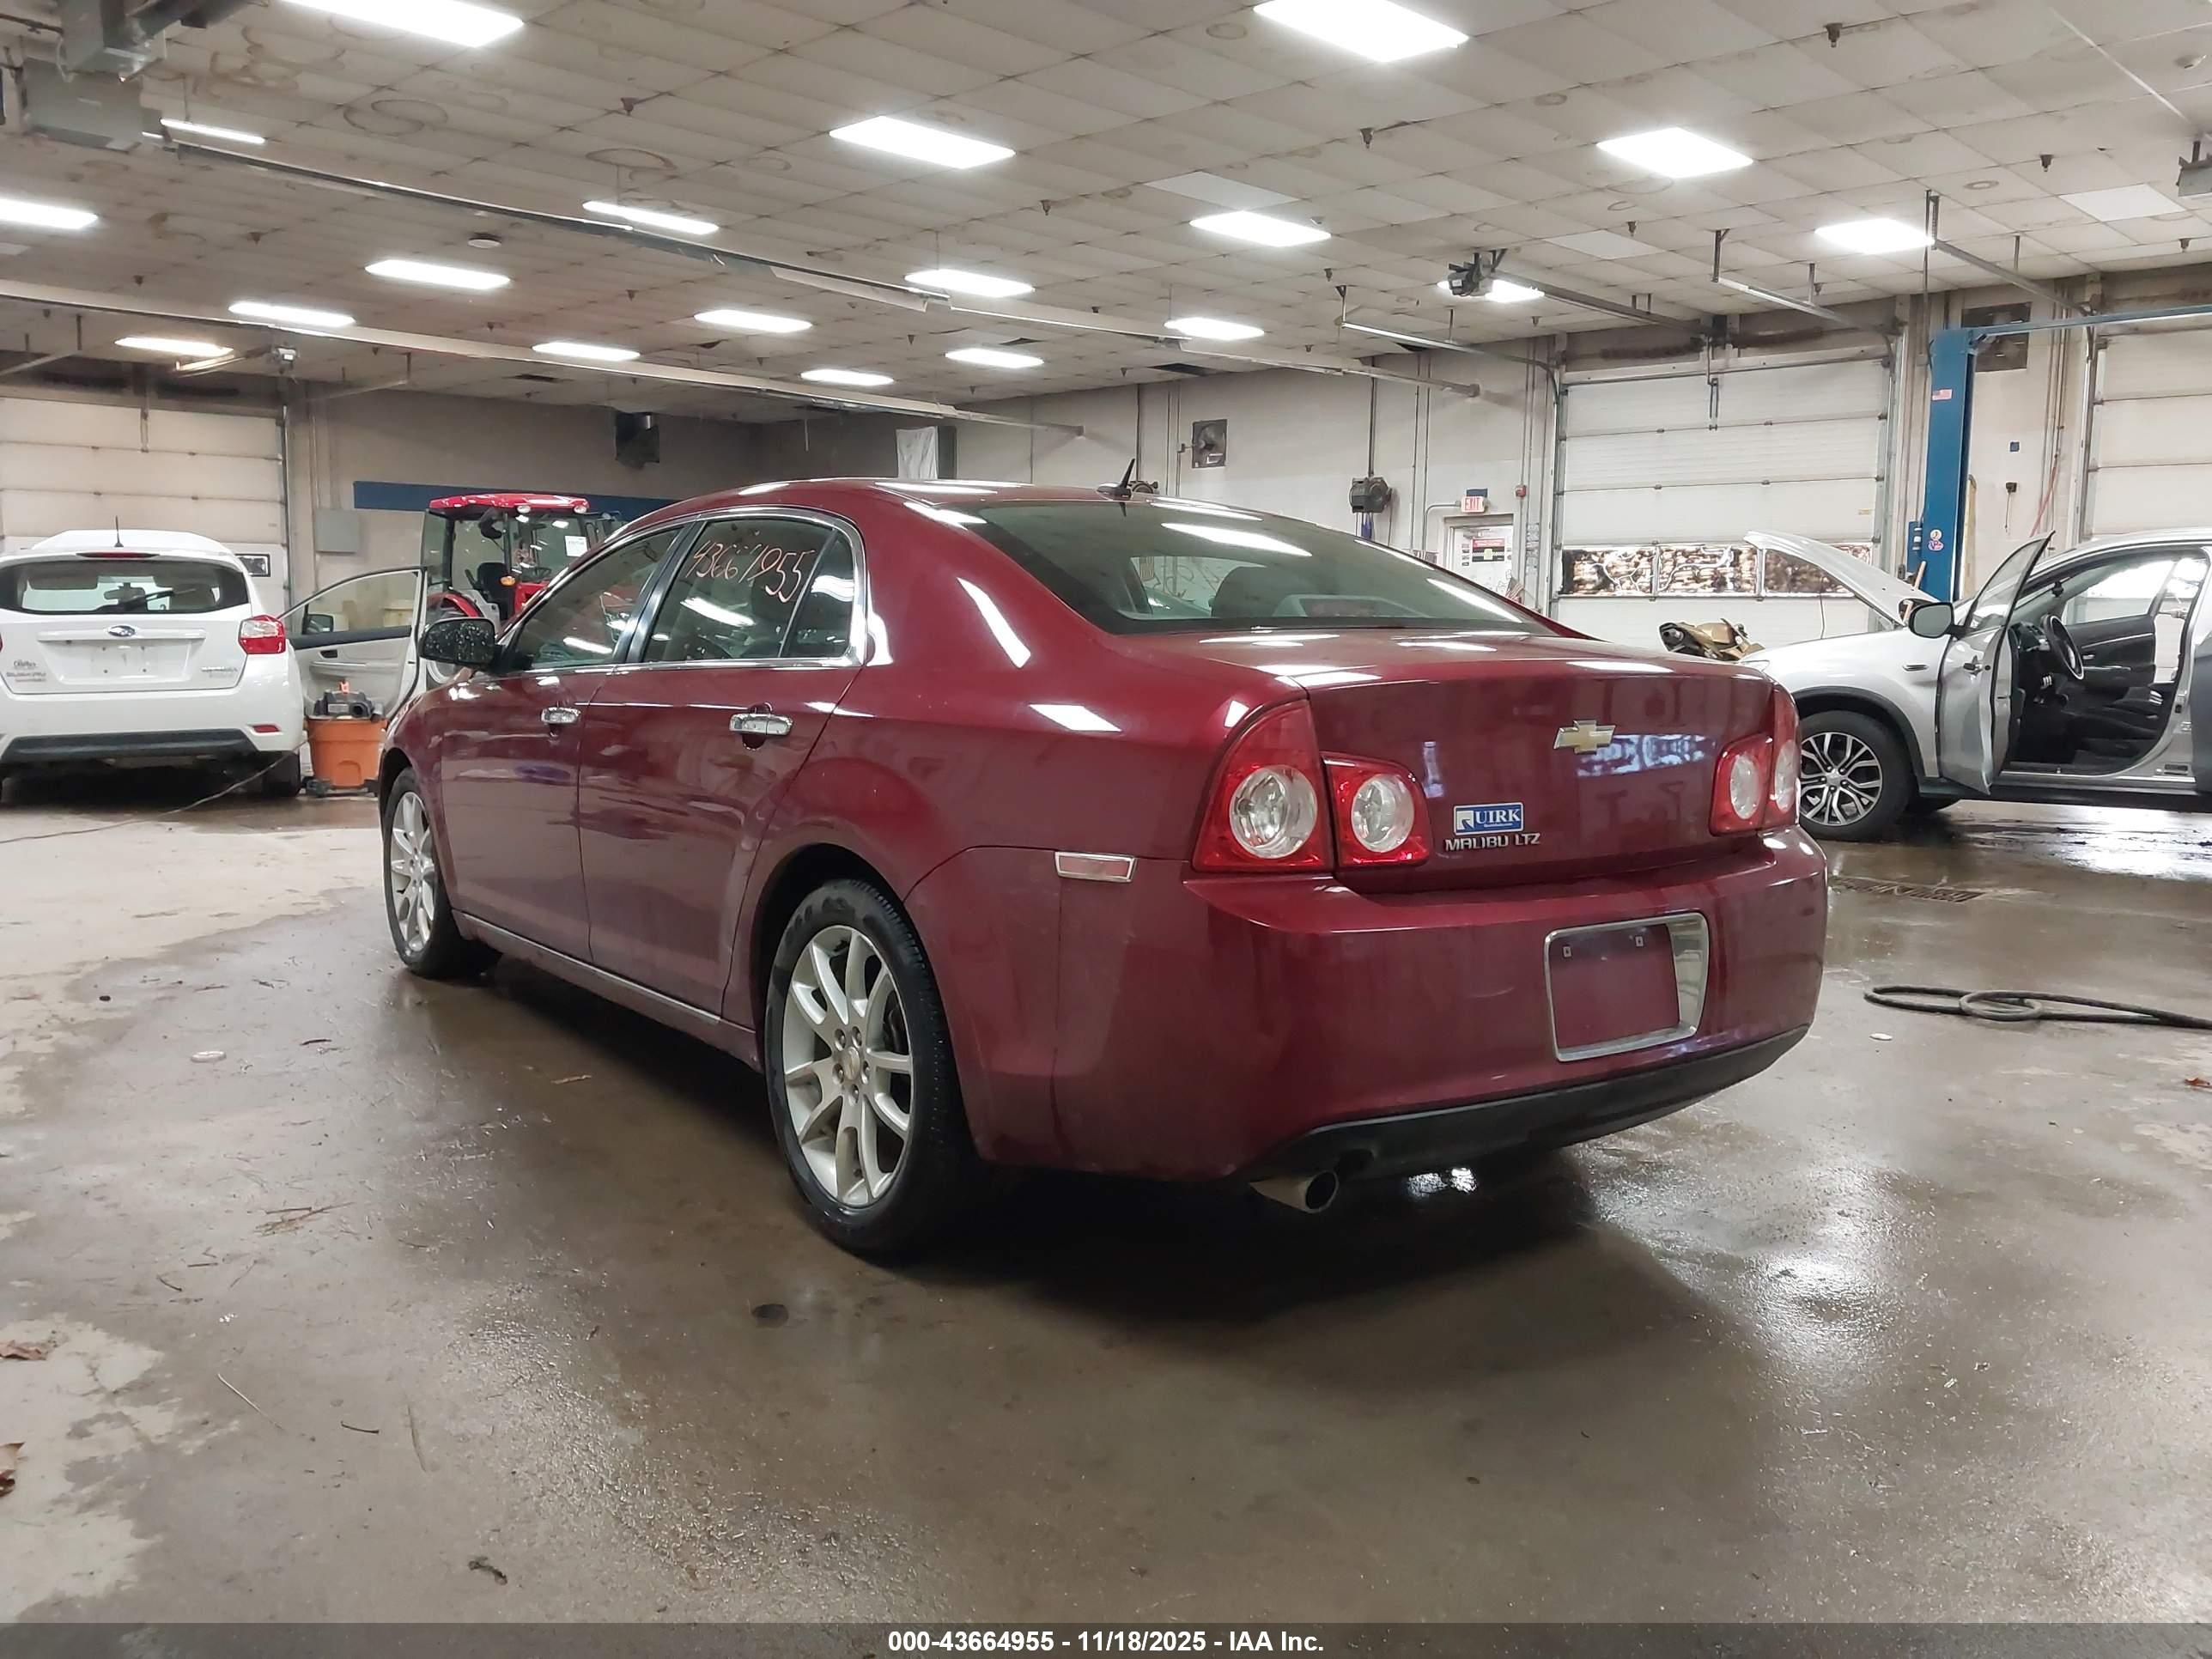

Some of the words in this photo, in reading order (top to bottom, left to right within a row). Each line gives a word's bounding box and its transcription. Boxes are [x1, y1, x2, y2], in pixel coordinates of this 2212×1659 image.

[1464, 497, 1480, 511] EXIT
[1444, 835, 1510, 852] MALIBU
[1514, 832, 1541, 846] LTZ
